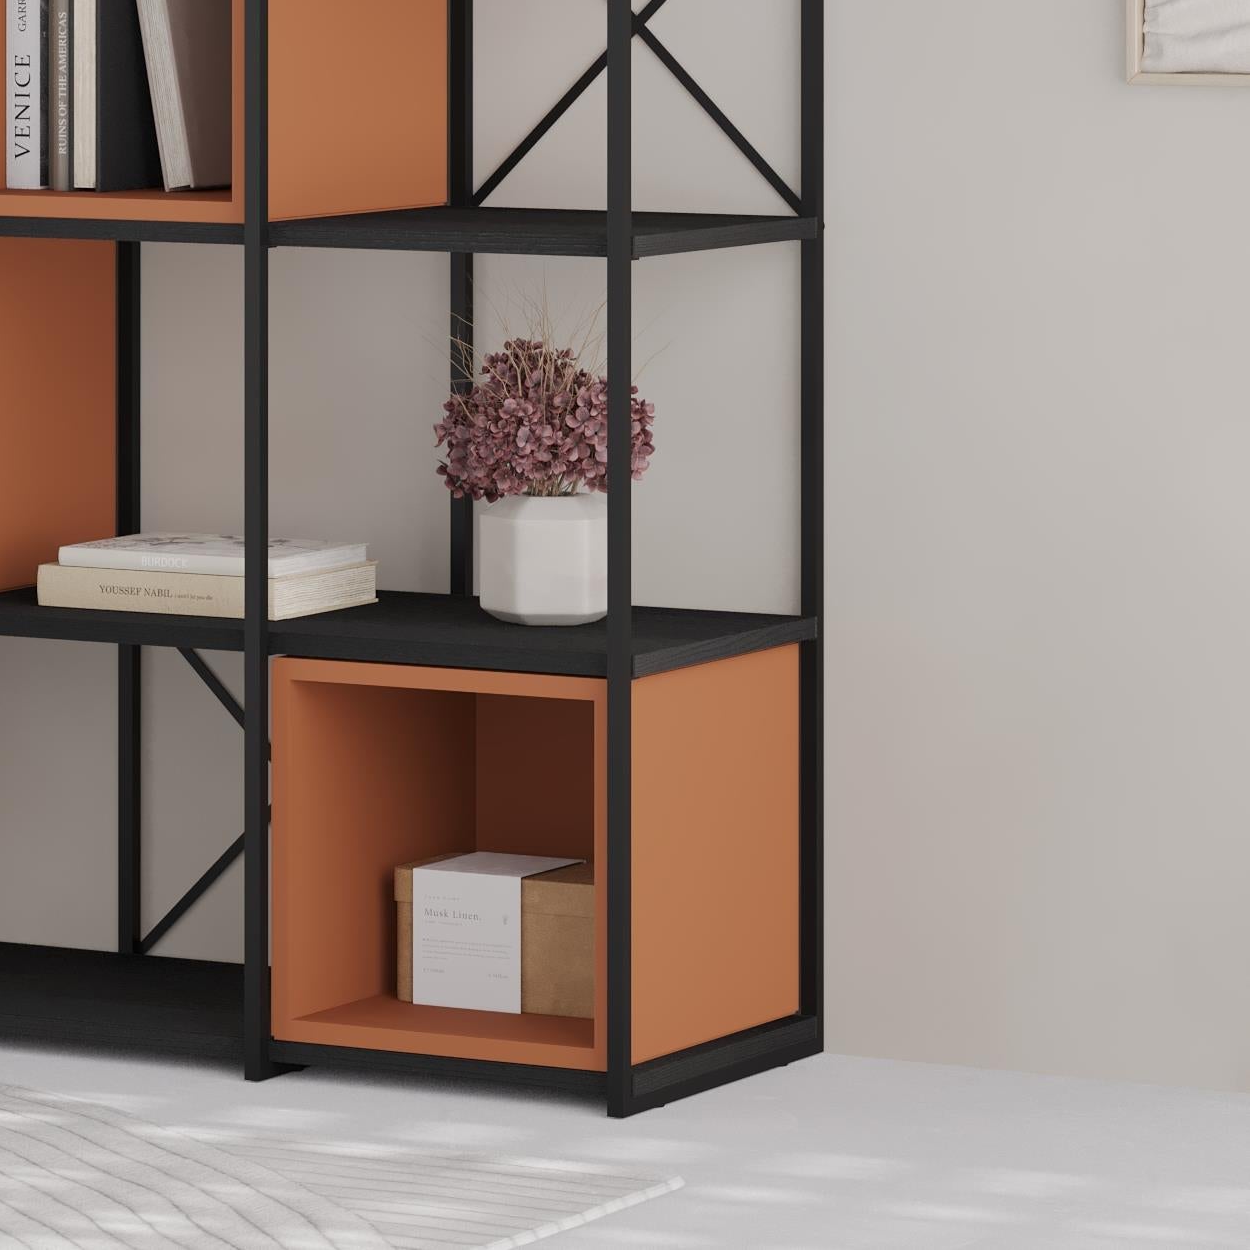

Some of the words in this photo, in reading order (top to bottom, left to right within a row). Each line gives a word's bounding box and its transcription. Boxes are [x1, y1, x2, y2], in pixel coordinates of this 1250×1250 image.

[58, 11, 68, 72] AMERICAS
[58, 74, 68, 98] THE
[14, 54, 31, 159] VENICE
[58, 100, 68, 117] OF
[58, 118, 68, 155] RUINS
[141, 555, 190, 569] BURDOCK
[99, 584, 142, 597] YOUSSEF
[143, 587, 173, 599] NABIL
[424, 907, 450, 918] Musk
